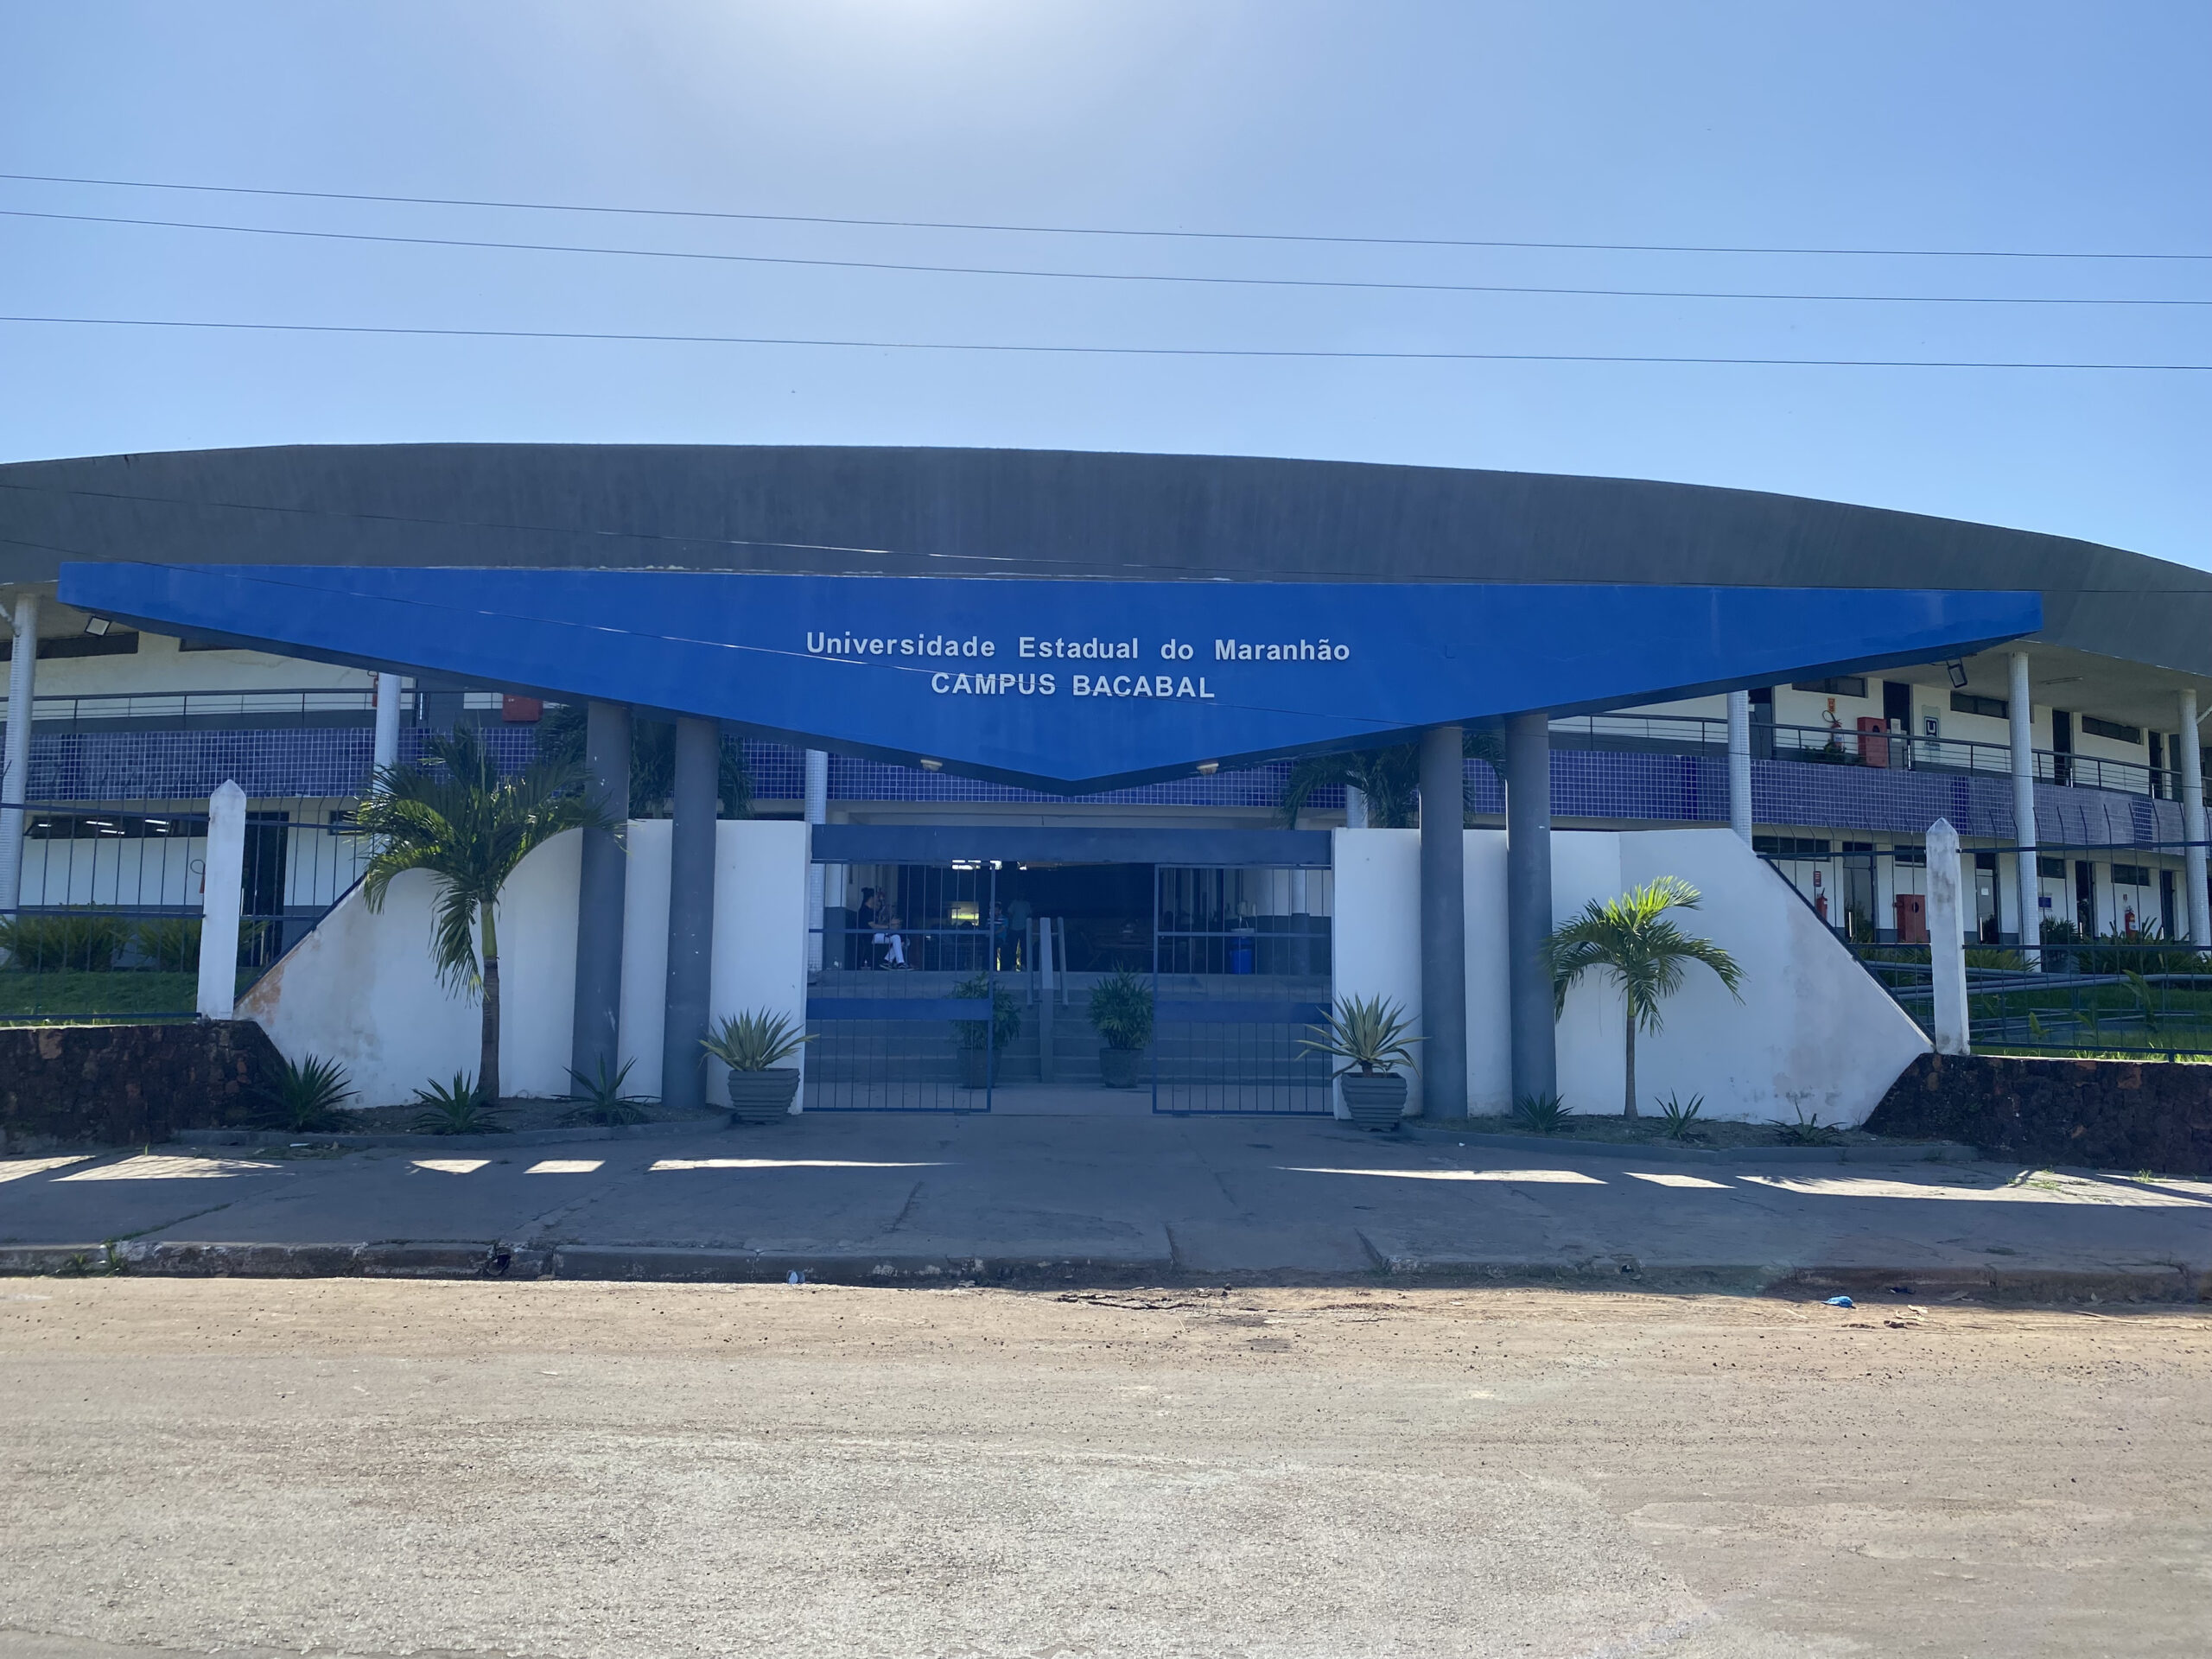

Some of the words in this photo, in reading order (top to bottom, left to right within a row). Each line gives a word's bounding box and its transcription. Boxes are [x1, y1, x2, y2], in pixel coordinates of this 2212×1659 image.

[805, 632, 995, 658] Universidade
[1020, 637, 1138, 658] Estadual
[1160, 639, 1193, 659] do
[1215, 639, 1350, 660] Maranhão
[931, 672, 1056, 695] CAMPUS
[1072, 675, 1215, 697] BACABAL
